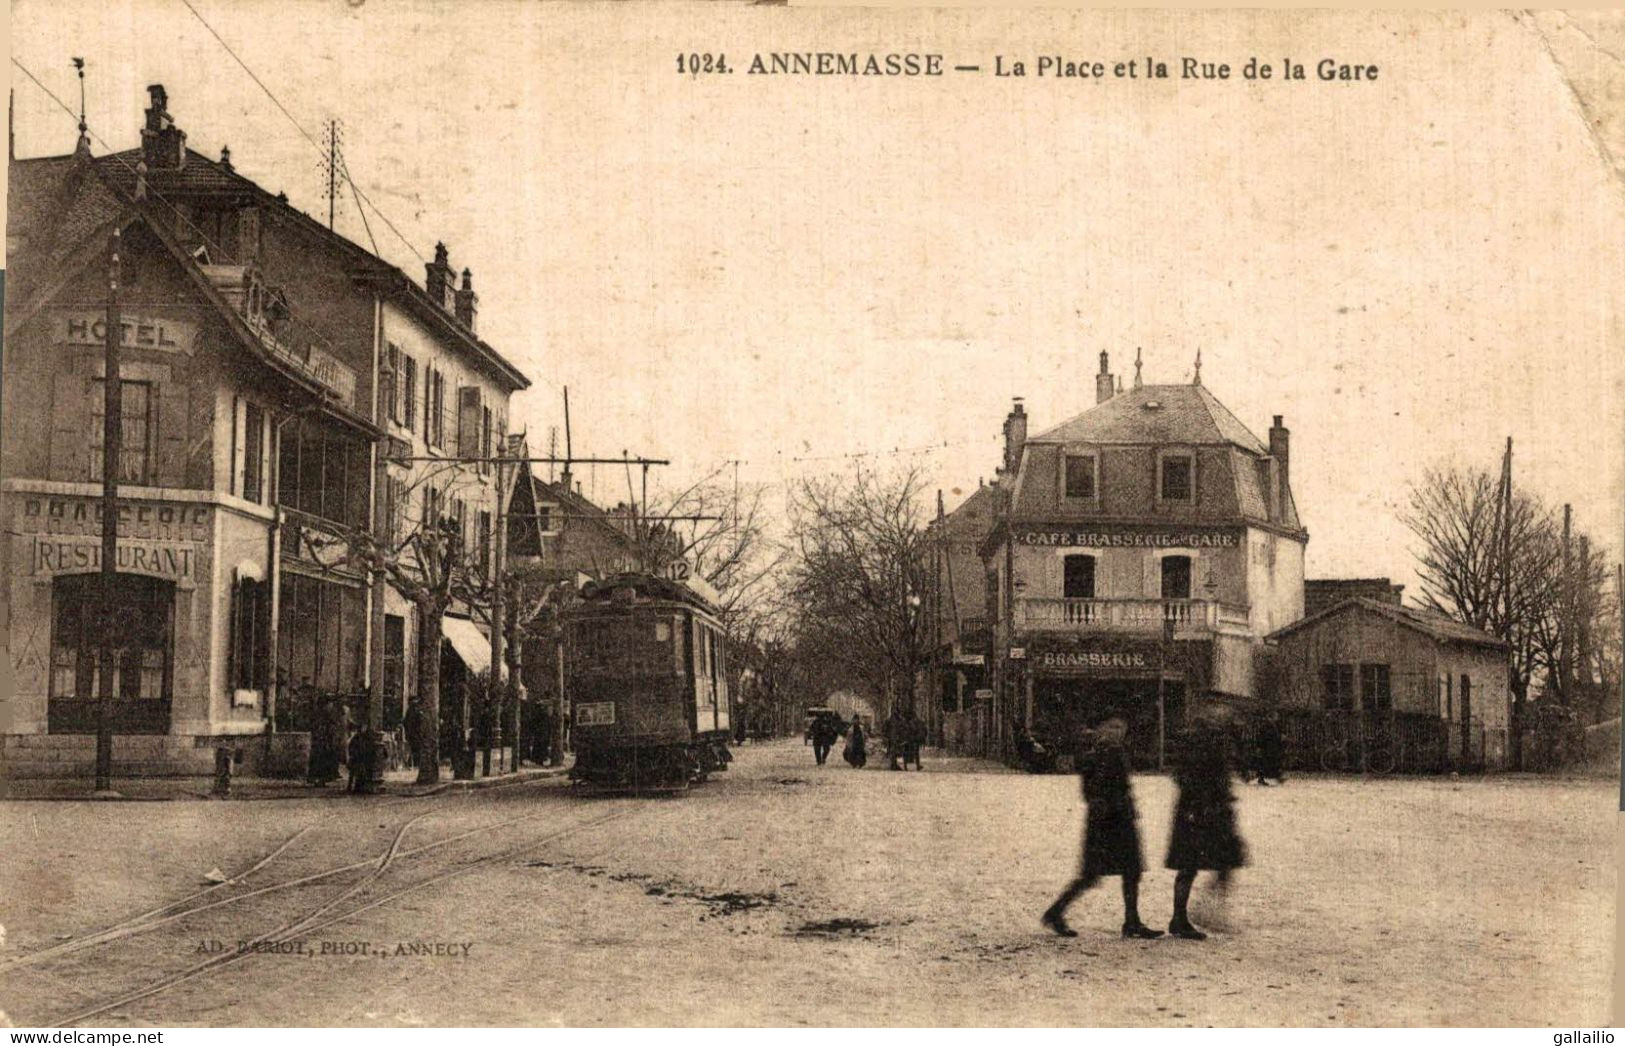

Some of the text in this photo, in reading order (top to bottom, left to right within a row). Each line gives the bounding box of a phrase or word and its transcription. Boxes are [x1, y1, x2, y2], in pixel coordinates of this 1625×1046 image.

[1076, 532, 1171, 547] BRASSERIE
[1188, 533, 1233, 547] GARE
[39, 541, 195, 576] RESTURANT
[670, 562, 689, 580] 12
[1044, 652, 1145, 666] BRASSERIE
